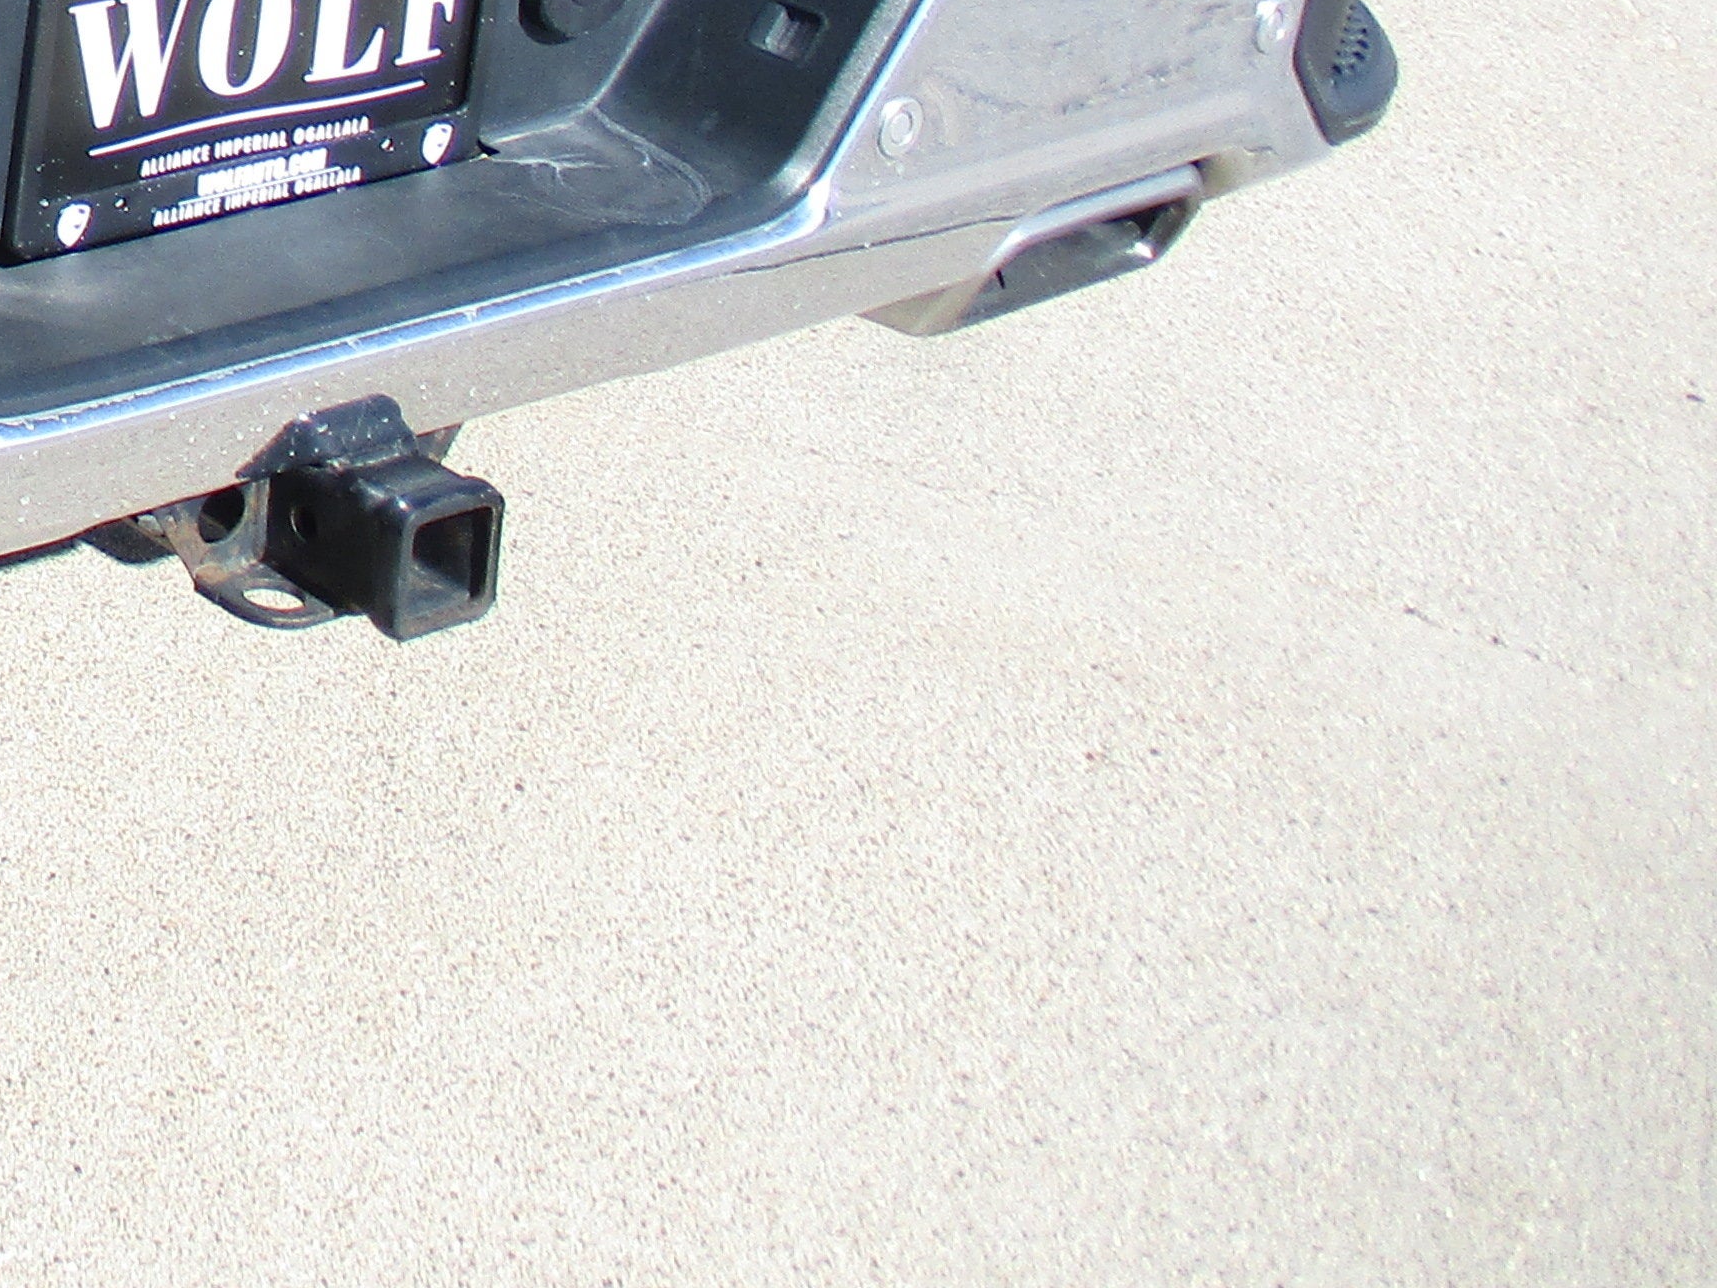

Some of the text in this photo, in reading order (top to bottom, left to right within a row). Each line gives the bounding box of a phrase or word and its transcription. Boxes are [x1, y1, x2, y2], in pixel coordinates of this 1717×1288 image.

[140, 115, 370, 179] ALLIANCE IMPERIAL OGALLALA
[152, 165, 362, 228] ALLIANCE IMPERIAL OGALLALA
